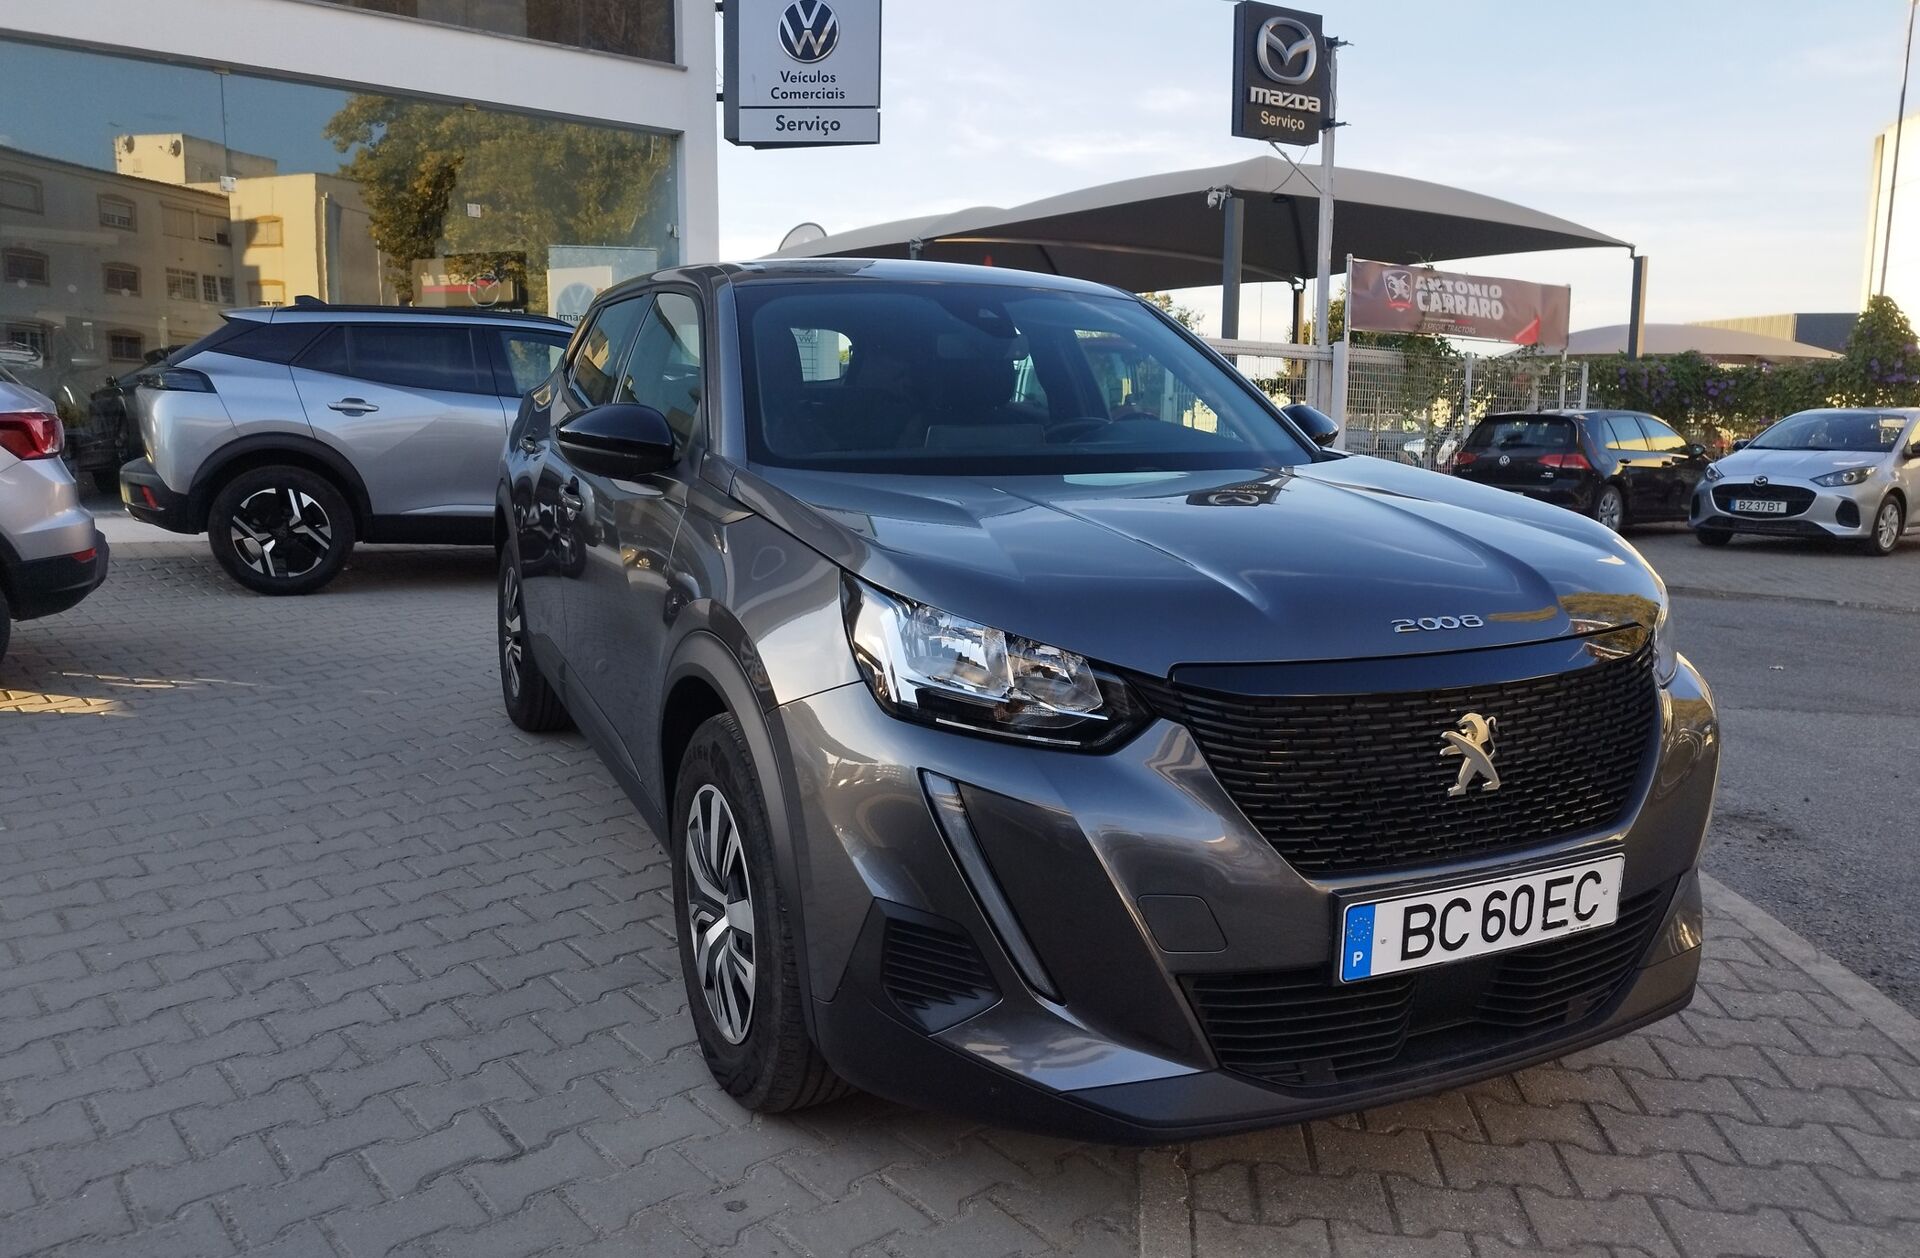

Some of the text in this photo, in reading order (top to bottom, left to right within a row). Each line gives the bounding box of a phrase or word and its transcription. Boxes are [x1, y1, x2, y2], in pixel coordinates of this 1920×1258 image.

[780, 70, 836, 84] Veículos
[771, 87, 846, 99] Comerciais
[1250, 86, 1321, 112] mazda
[775, 115, 841, 135] Serviço
[1260, 110, 1305, 131] Serviço
[1415, 275, 1503, 298] ANTONIO
[1416, 290, 1505, 321] CARRARO
[1390, 614, 1484, 633] 2008
[1353, 870, 1602, 968] P BC 60 EC
